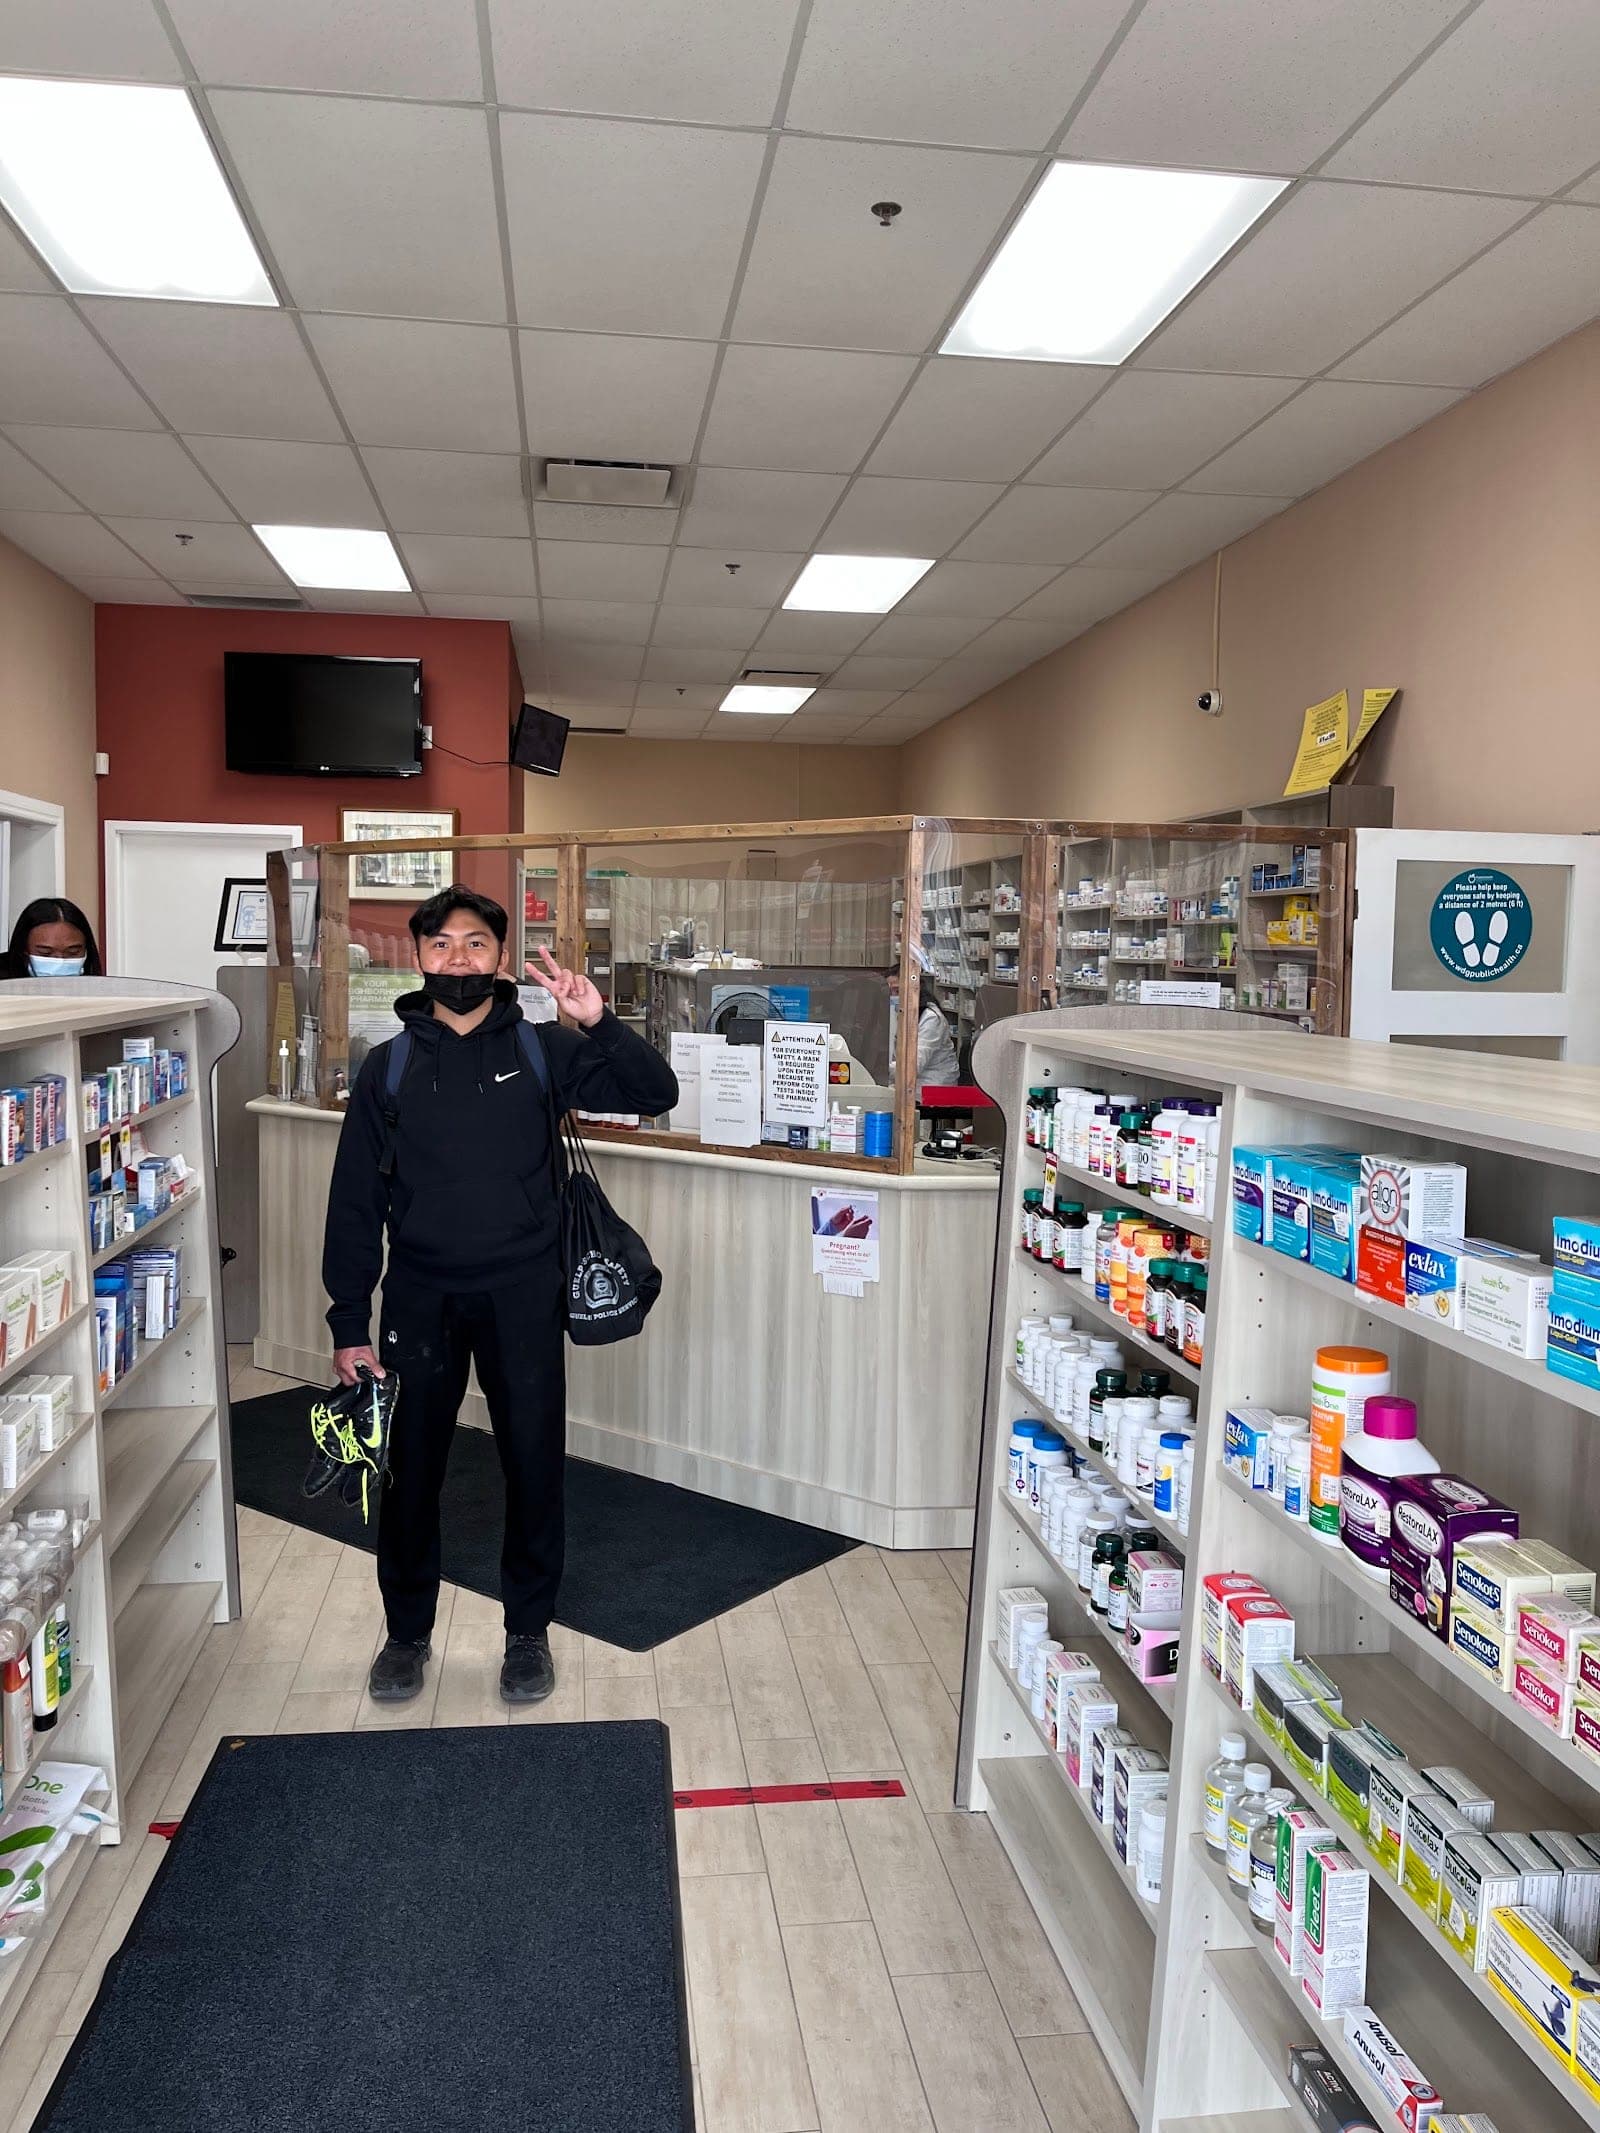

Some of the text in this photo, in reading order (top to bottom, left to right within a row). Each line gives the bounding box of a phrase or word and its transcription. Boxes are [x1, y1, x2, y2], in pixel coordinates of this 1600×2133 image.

[1478, 884, 1491, 892] help
[1493, 883, 1507, 891] keep
[1487, 892, 1494, 900] by
[1496, 892, 1520, 900] keeping
[1440, 944, 1523, 978] www.wdgpublichealth.ca
[773, 1080, 800, 1088] PERFORM
[1274, 1176, 1308, 1198] Imodium
[1312, 1190, 1348, 1214] Imodium
[1371, 1179, 1398, 1213] align
[829, 1242, 860, 1250] Pregnant?
[1556, 1234, 1600, 1258] Imodiu
[593, 1310, 618, 1320] POLICE
[618, 1296, 638, 1314] SERVIC
[1398, 1506, 1439, 1545] RestoraLAX
[1524, 1619, 1560, 1654] Senokot
[1520, 1672, 1555, 1709] Senokot
[1370, 1778, 1400, 1817] Dulcolax
[1408, 1816, 1439, 1856] Dulcolax
[1280, 1846, 1294, 1902] Fleet
[1445, 1854, 1477, 1899] Dulcolax
[1309, 1885, 1320, 1943] Fleet
[1353, 2030, 1385, 2075] Anusol
[1364, 2020, 1405, 2057] Anusol
